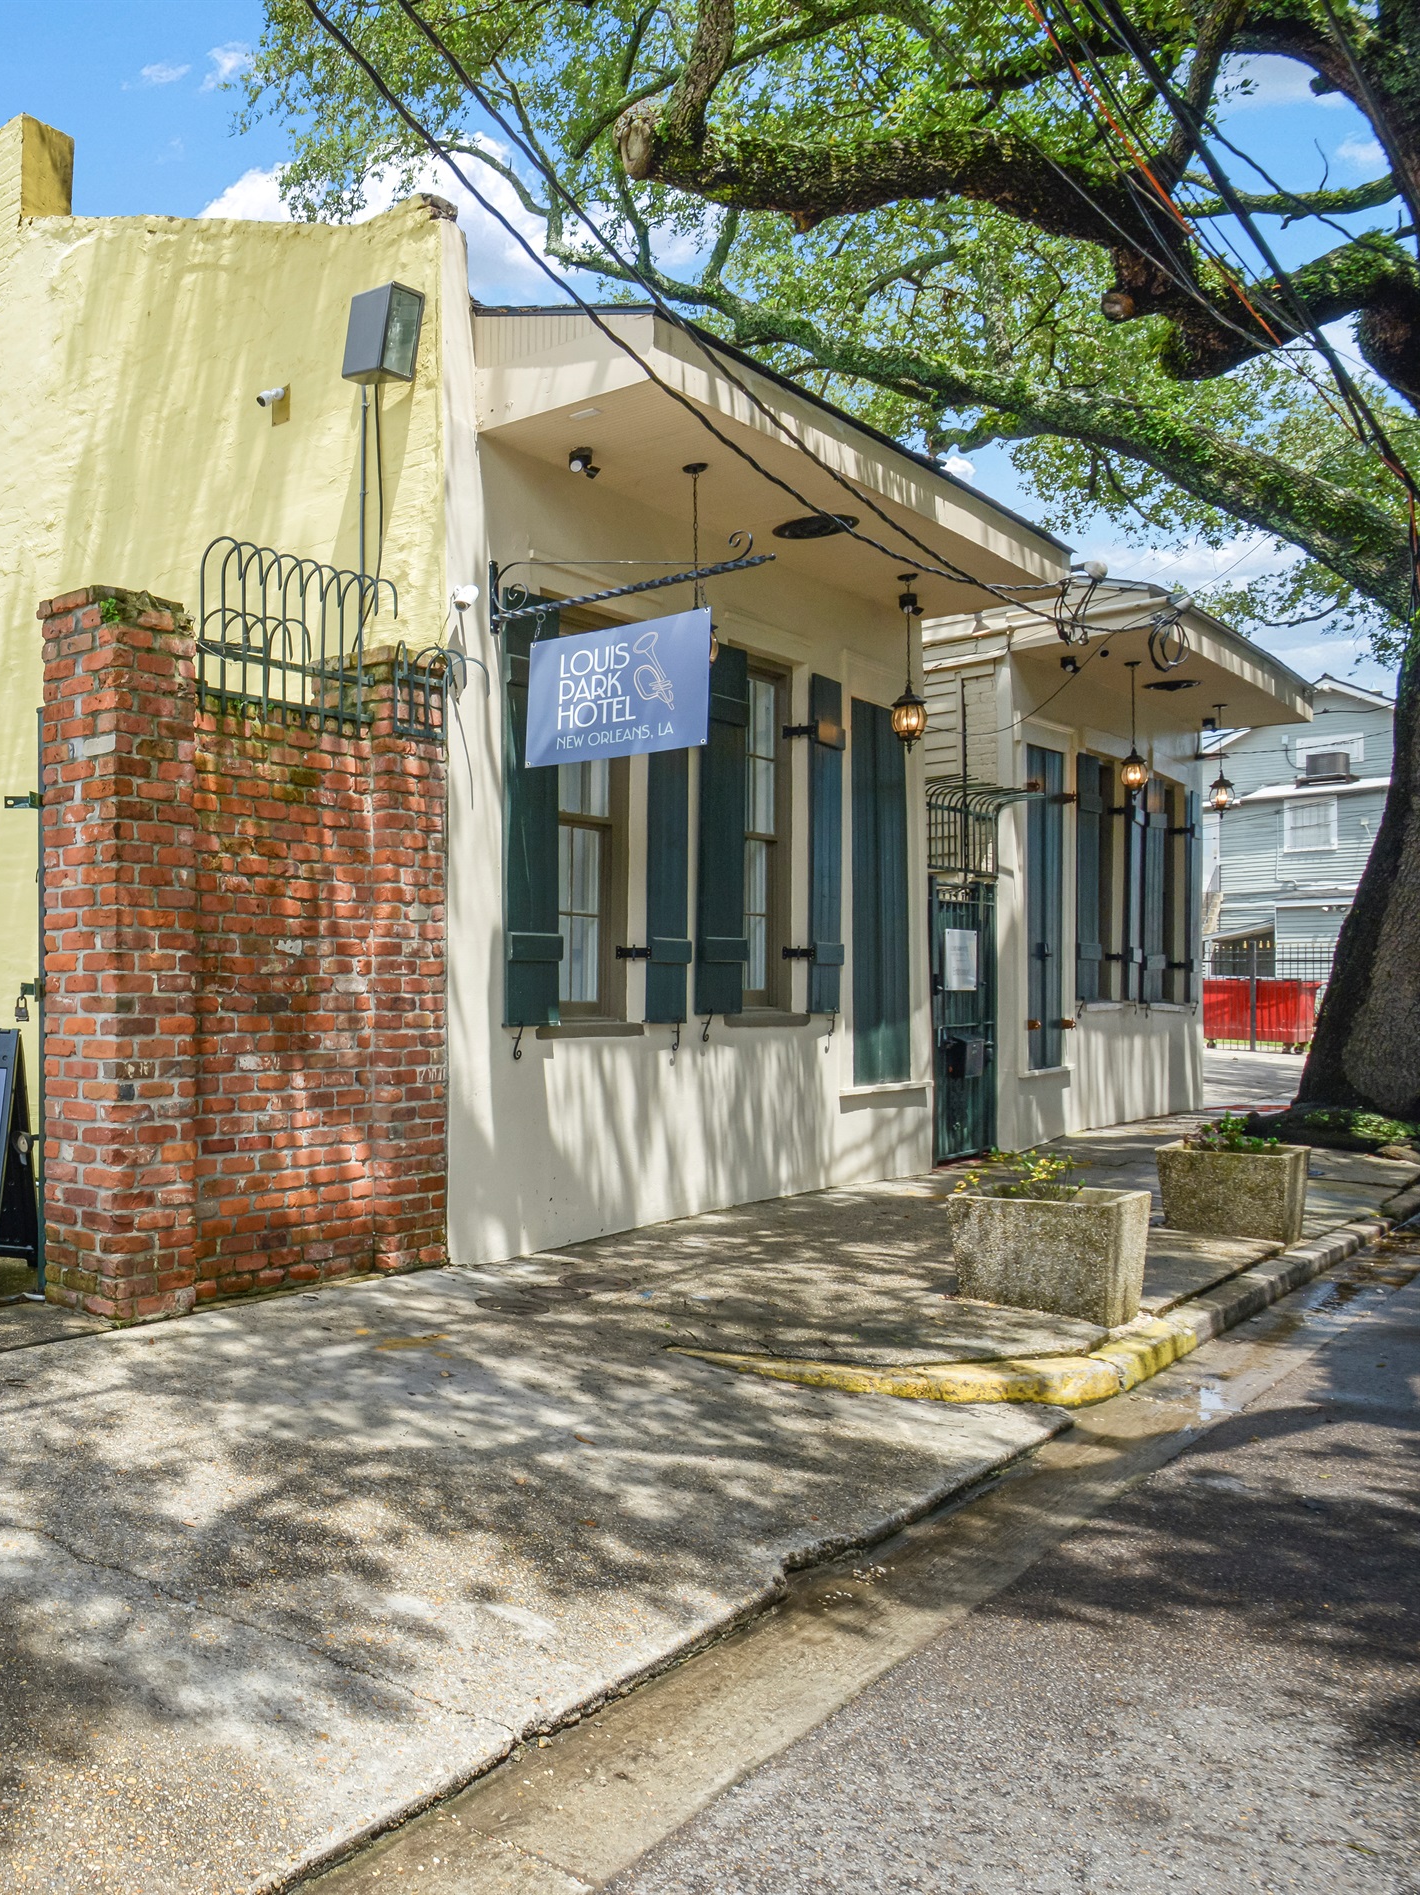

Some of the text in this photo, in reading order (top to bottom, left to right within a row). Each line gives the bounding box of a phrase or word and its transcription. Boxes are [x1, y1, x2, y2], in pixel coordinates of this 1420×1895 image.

[560, 643, 630, 679] LOUIS
[558, 671, 622, 704] PARK
[557, 696, 636, 730] HOTEL
[556, 721, 674, 750] NEW ORLEANS, LA
